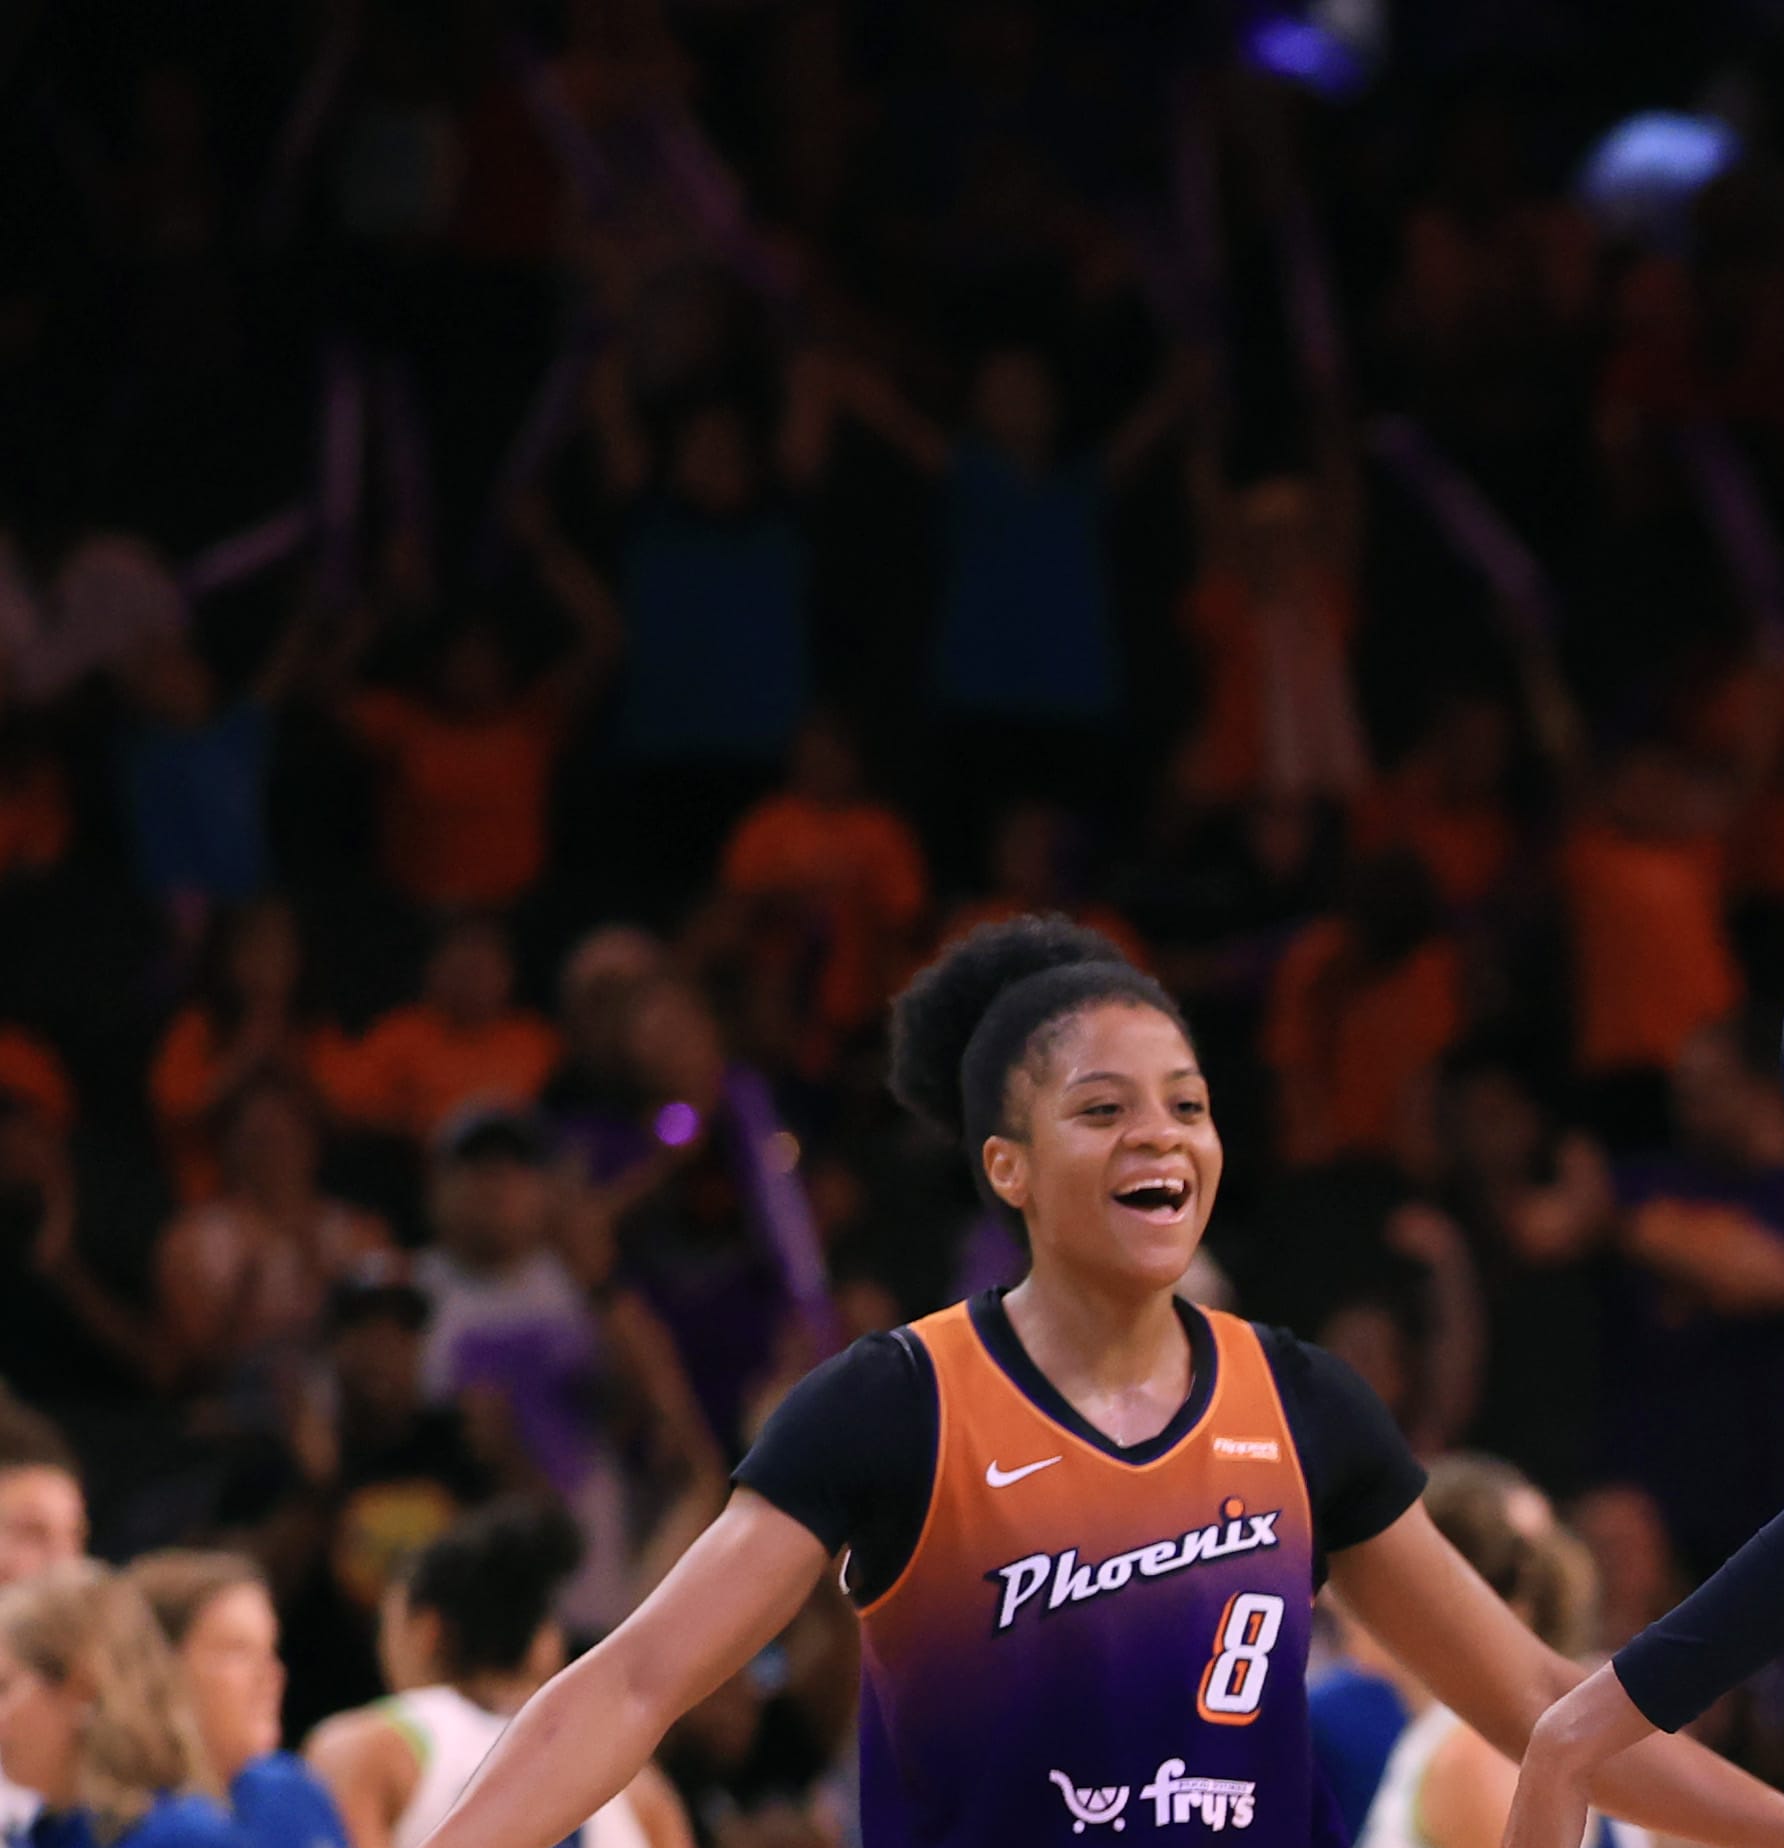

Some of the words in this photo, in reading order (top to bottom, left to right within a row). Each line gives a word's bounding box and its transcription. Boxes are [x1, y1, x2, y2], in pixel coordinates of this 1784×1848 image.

[997, 1496, 1281, 1630] Phoenix
[1197, 1591, 1285, 1726] 8
[1138, 1757, 1257, 1832] fry's
